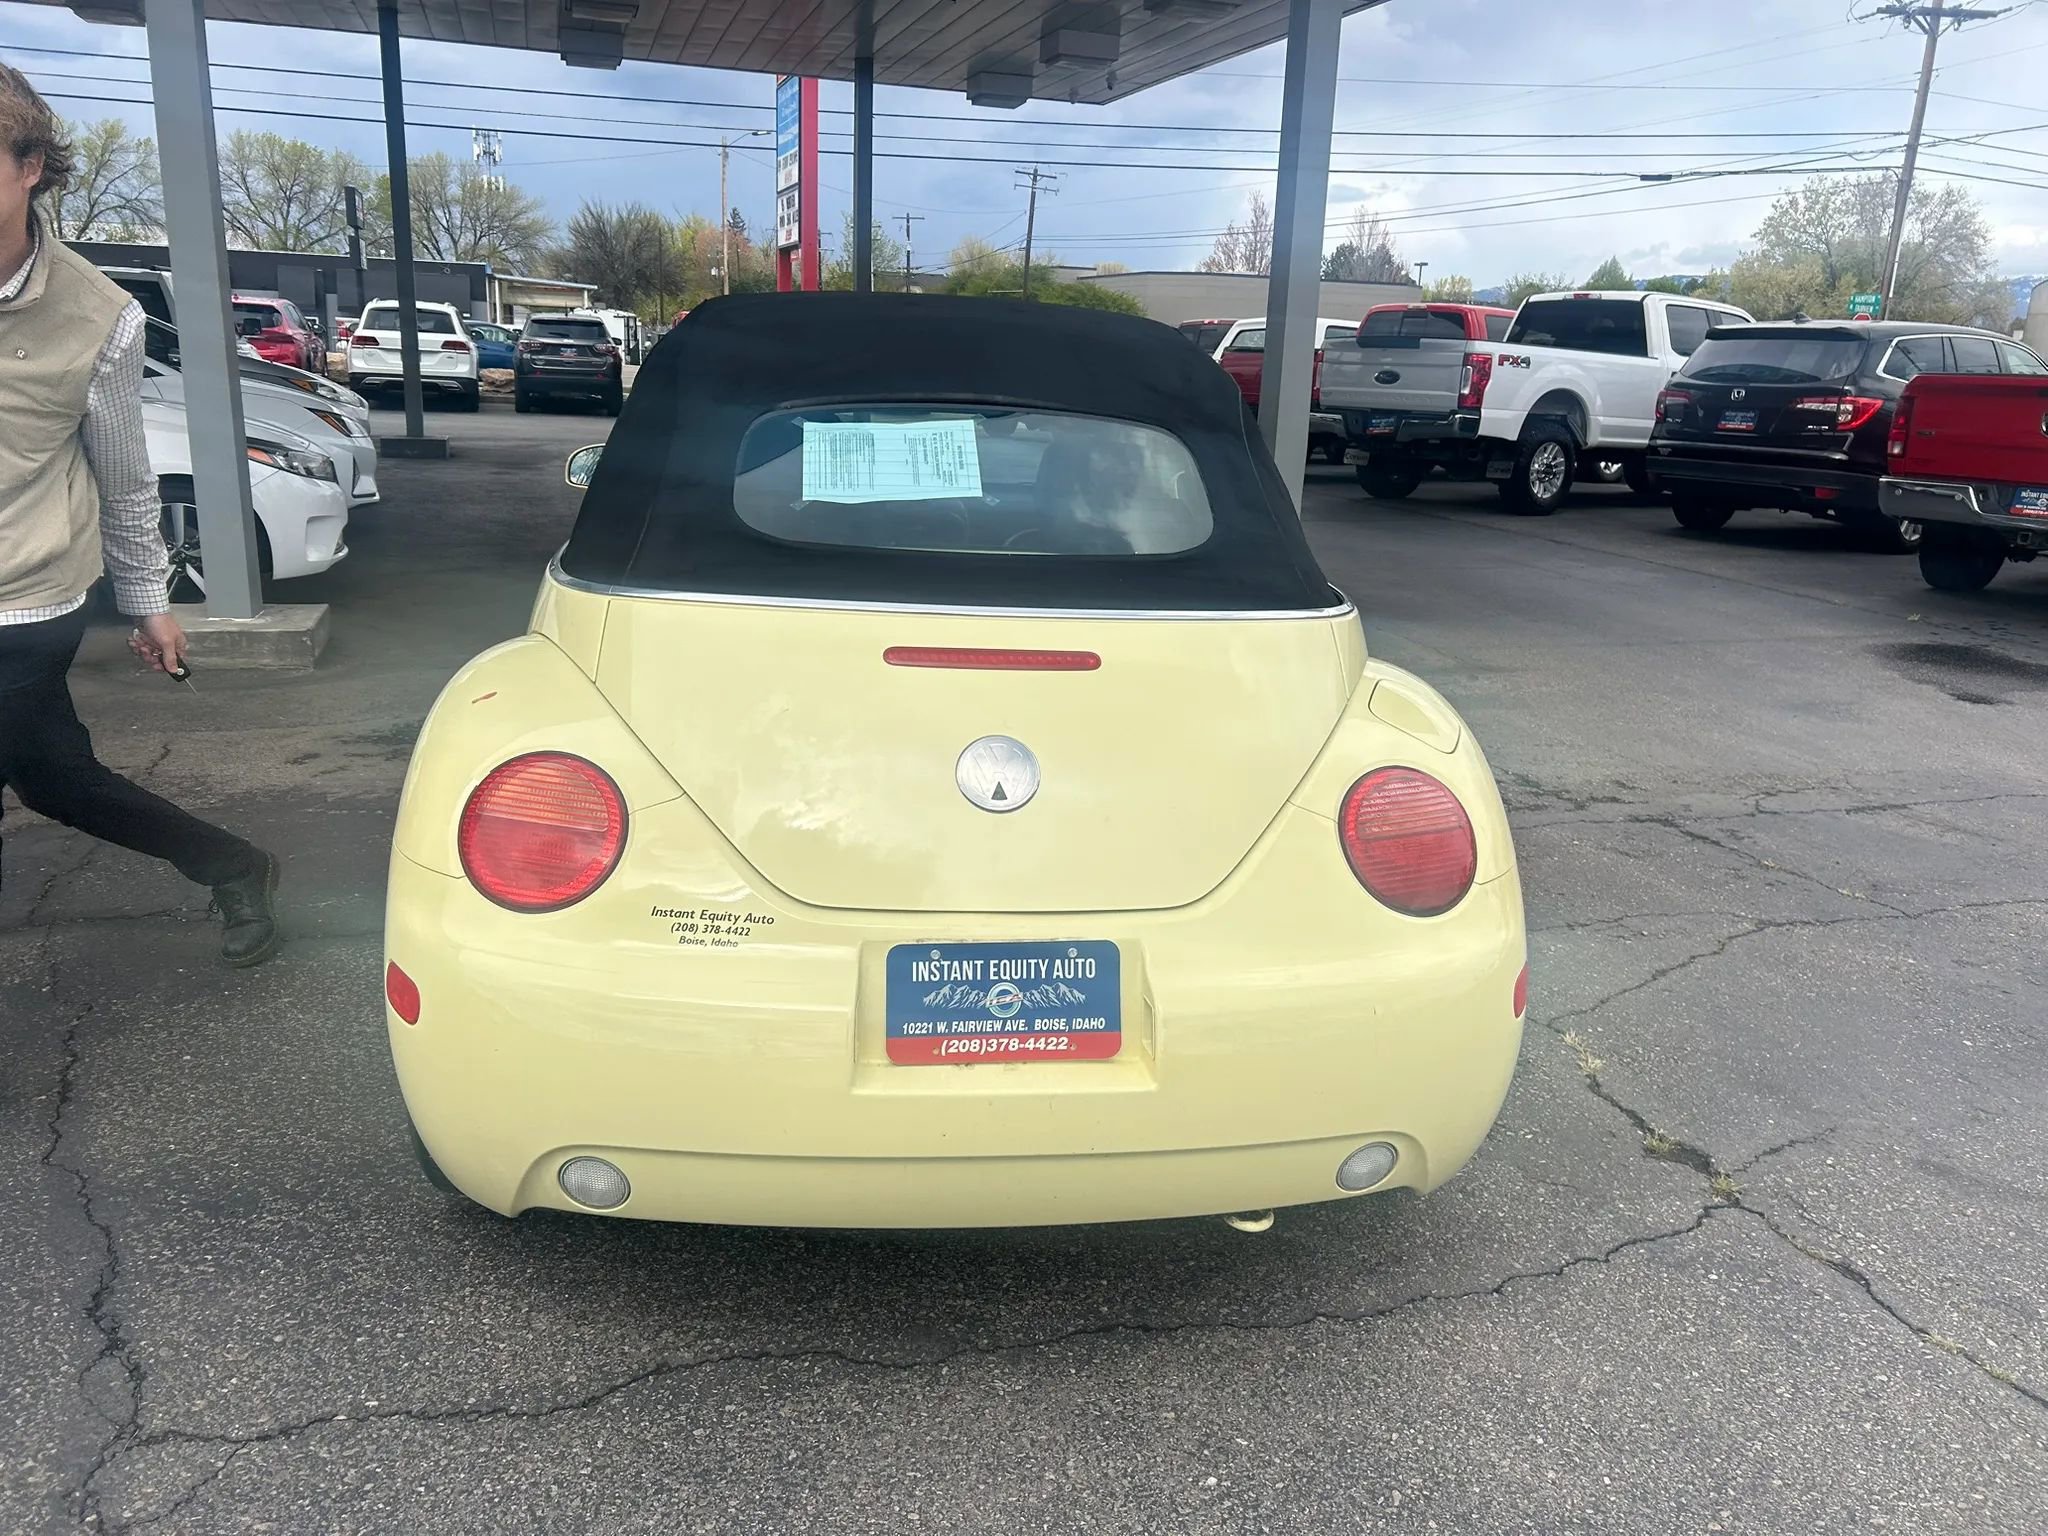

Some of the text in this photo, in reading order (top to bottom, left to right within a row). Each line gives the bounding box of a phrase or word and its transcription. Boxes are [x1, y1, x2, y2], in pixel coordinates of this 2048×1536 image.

[1497, 354, 1531, 369] FX4
[651, 906, 775, 925] Instant Equity Auto
[670, 922, 751, 937] (208) 378-4422
[678, 935, 739, 948] Boise, Idaho
[912, 957, 1096, 982] INSTANT EQUITY AUTO
[902, 1017, 1106, 1035] 10221 W. FAIRVIEW AVE. BOISE, IDAHO
[940, 1036, 1069, 1056] (208)378-4422
